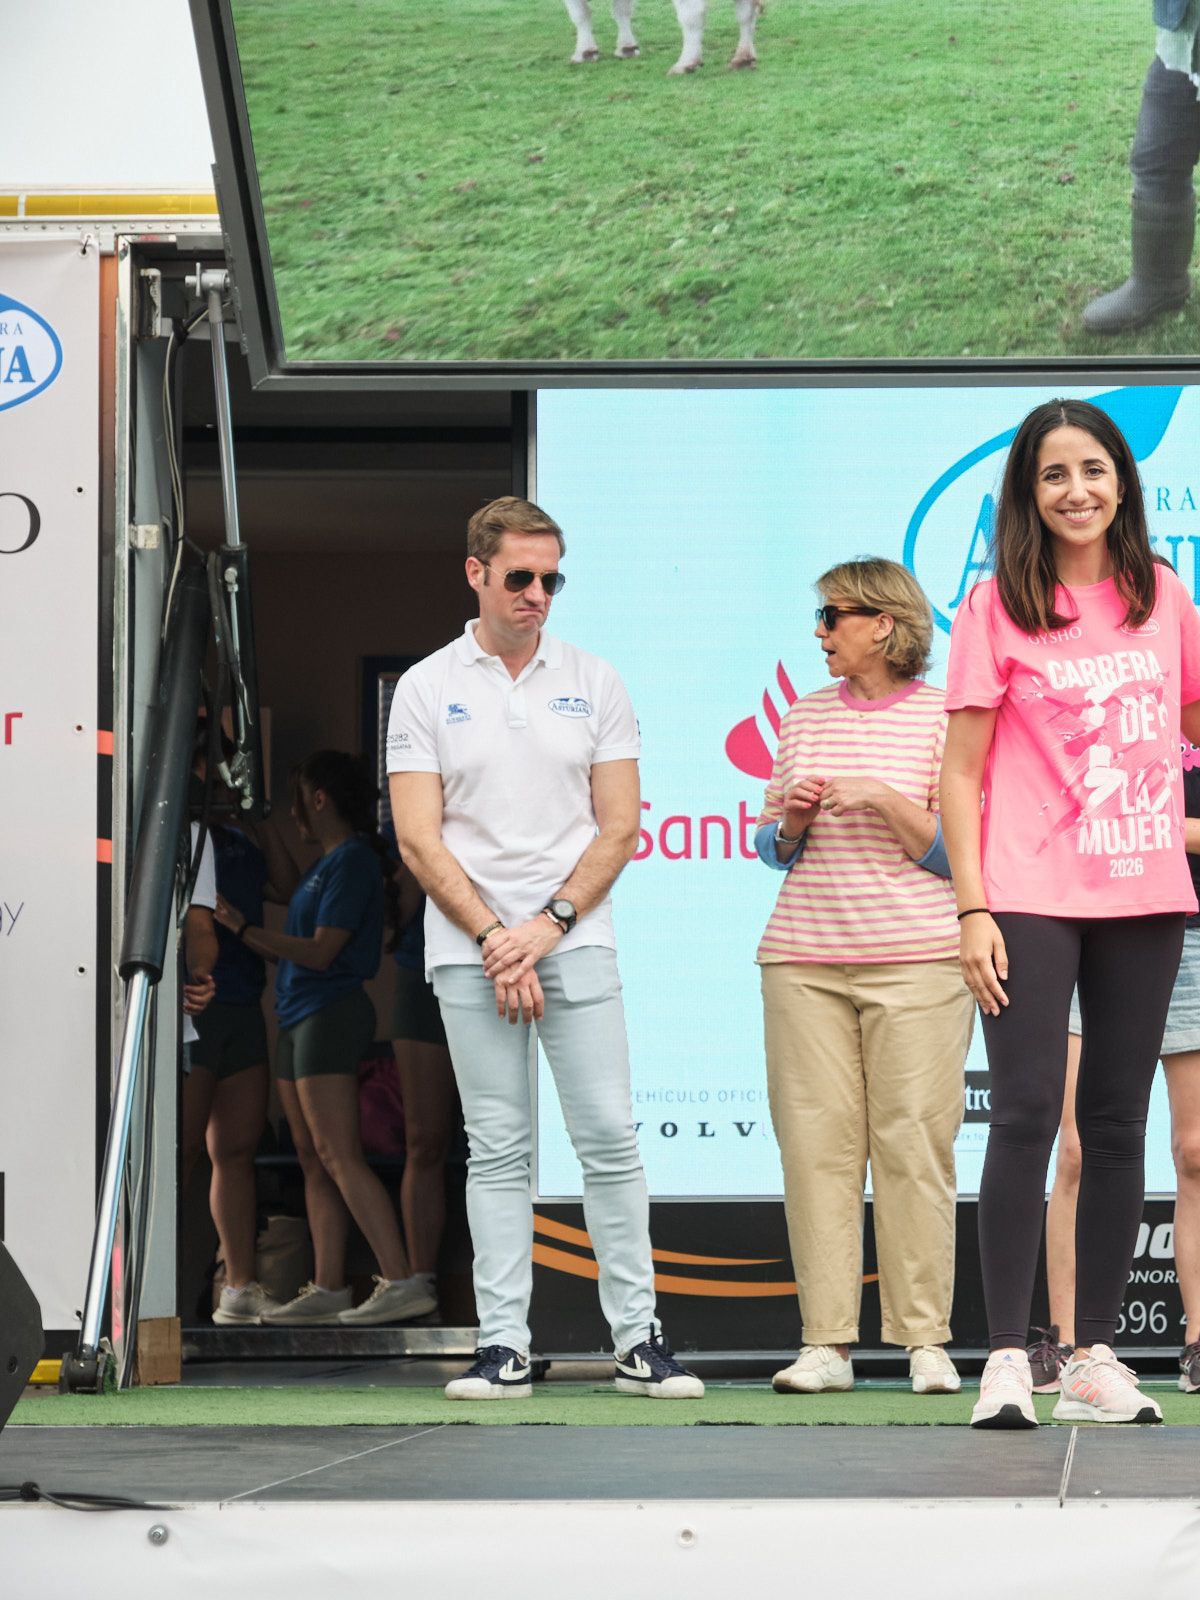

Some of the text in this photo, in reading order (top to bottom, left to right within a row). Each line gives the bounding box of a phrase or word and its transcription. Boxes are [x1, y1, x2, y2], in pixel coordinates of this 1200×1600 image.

[0, 345, 36, 383] A
[1028, 626, 1082, 645] OYSHO
[1046, 649, 1164, 690] CARRERA
[1119, 695, 1157, 744] DE
[1119, 770, 1151, 816] LA
[1077, 812, 1173, 856] MUJER
[1109, 858, 1144, 878] 2026
[0, 902, 24, 937] y
